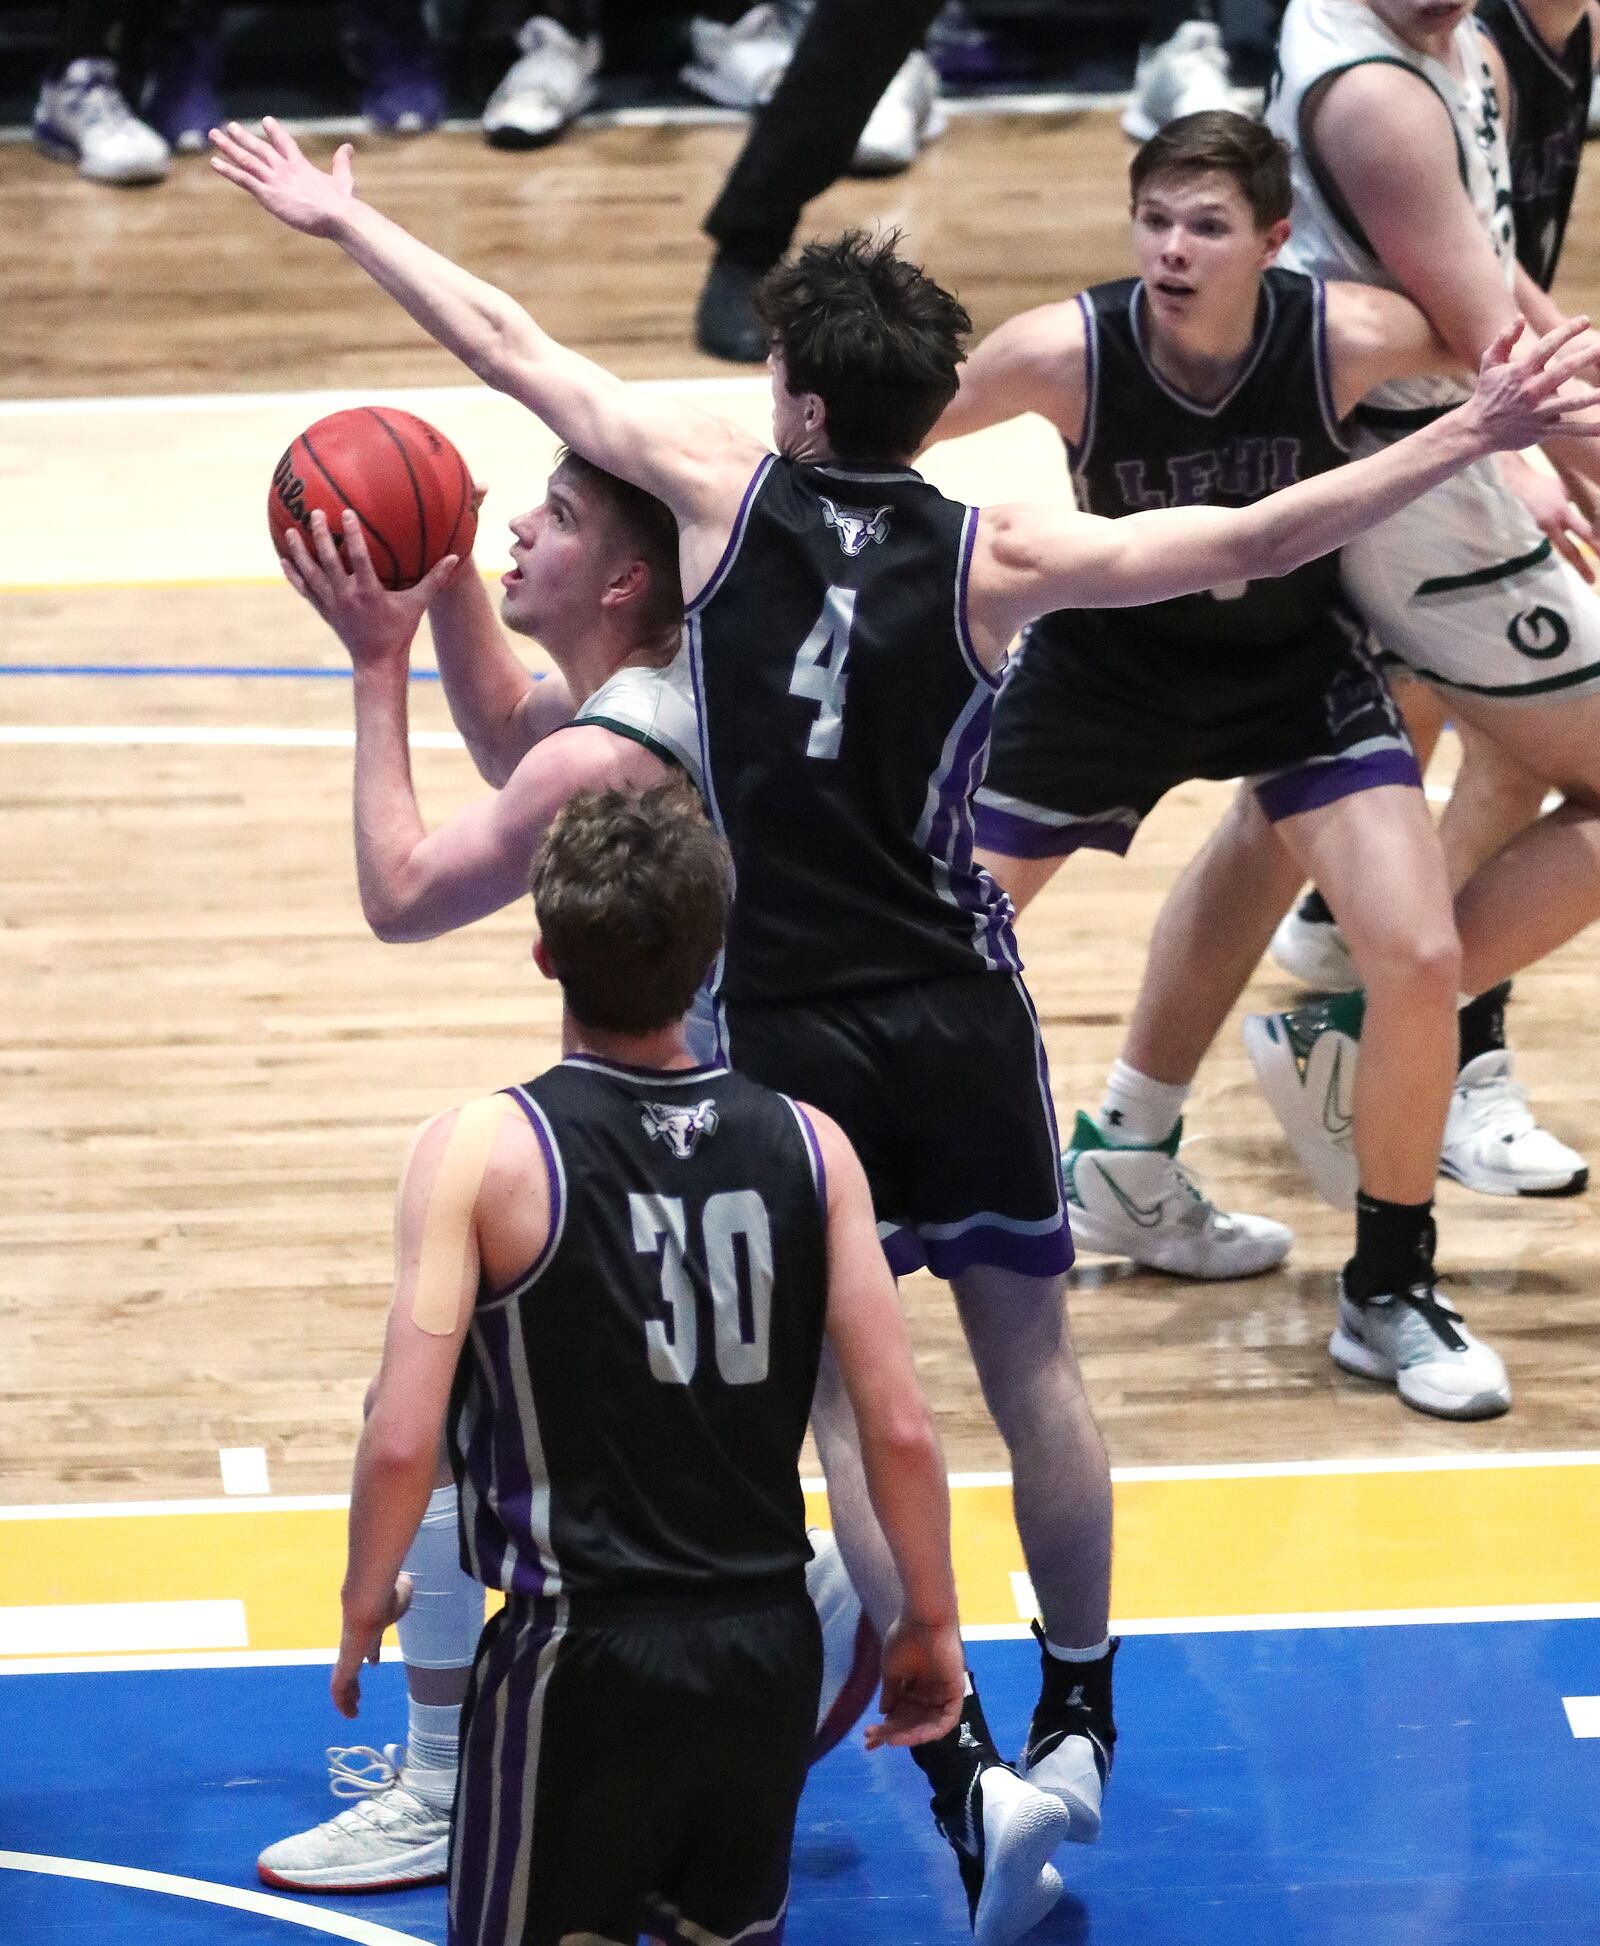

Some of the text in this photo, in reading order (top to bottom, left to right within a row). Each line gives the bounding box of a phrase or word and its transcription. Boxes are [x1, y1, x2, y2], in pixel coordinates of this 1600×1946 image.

[1115, 437, 1300, 508] LEHI
[788, 584, 857, 760] 4
[628, 1189, 775, 1385] 30
